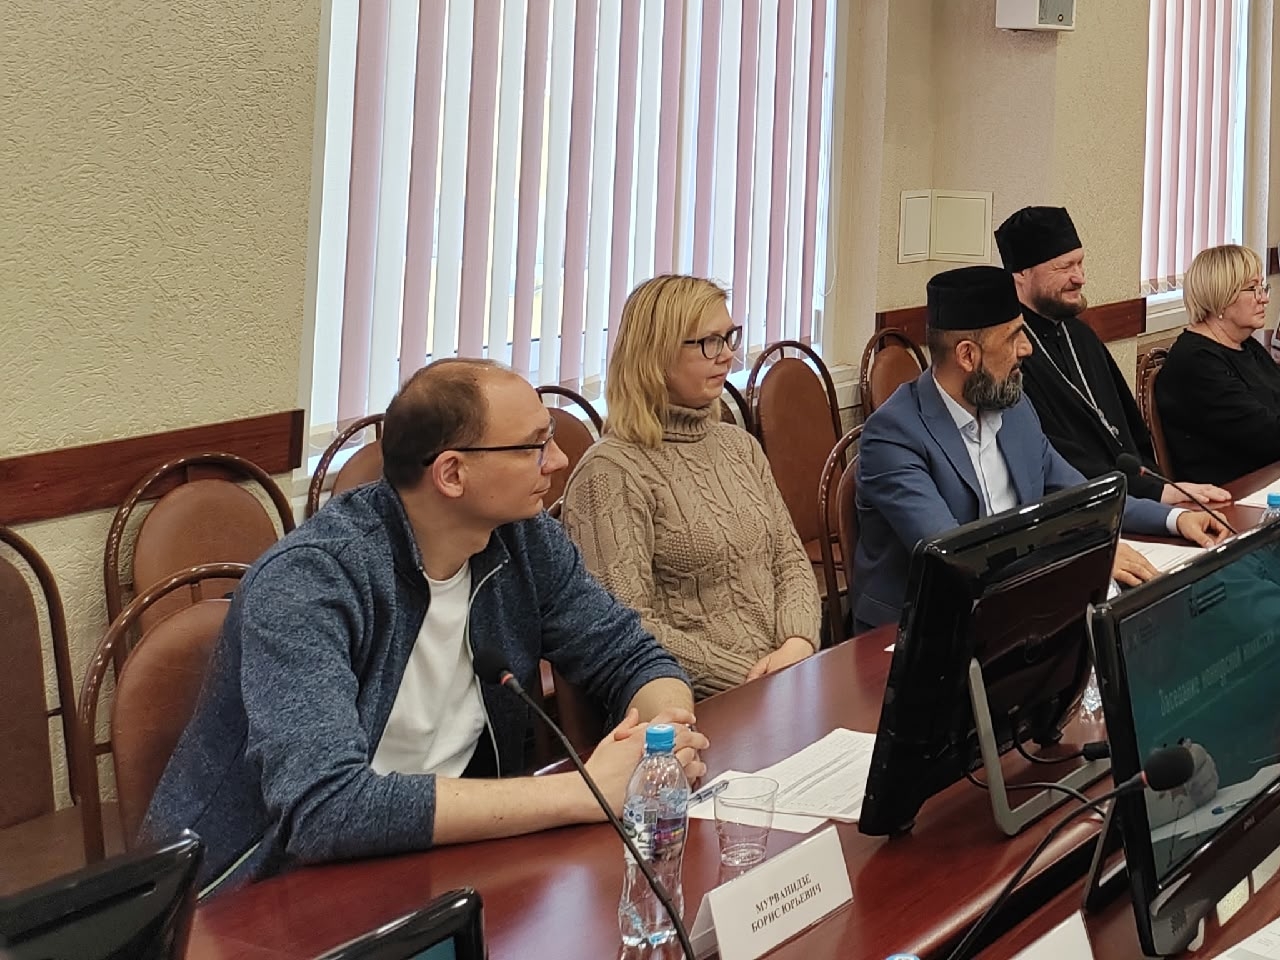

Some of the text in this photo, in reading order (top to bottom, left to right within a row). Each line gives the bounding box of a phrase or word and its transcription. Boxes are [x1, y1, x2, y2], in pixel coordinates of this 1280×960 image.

[751, 883, 822, 934] БОРИС ЮРЬЕВИЧ
[755, 873, 812, 914] МУРВАНИДЗЕ
